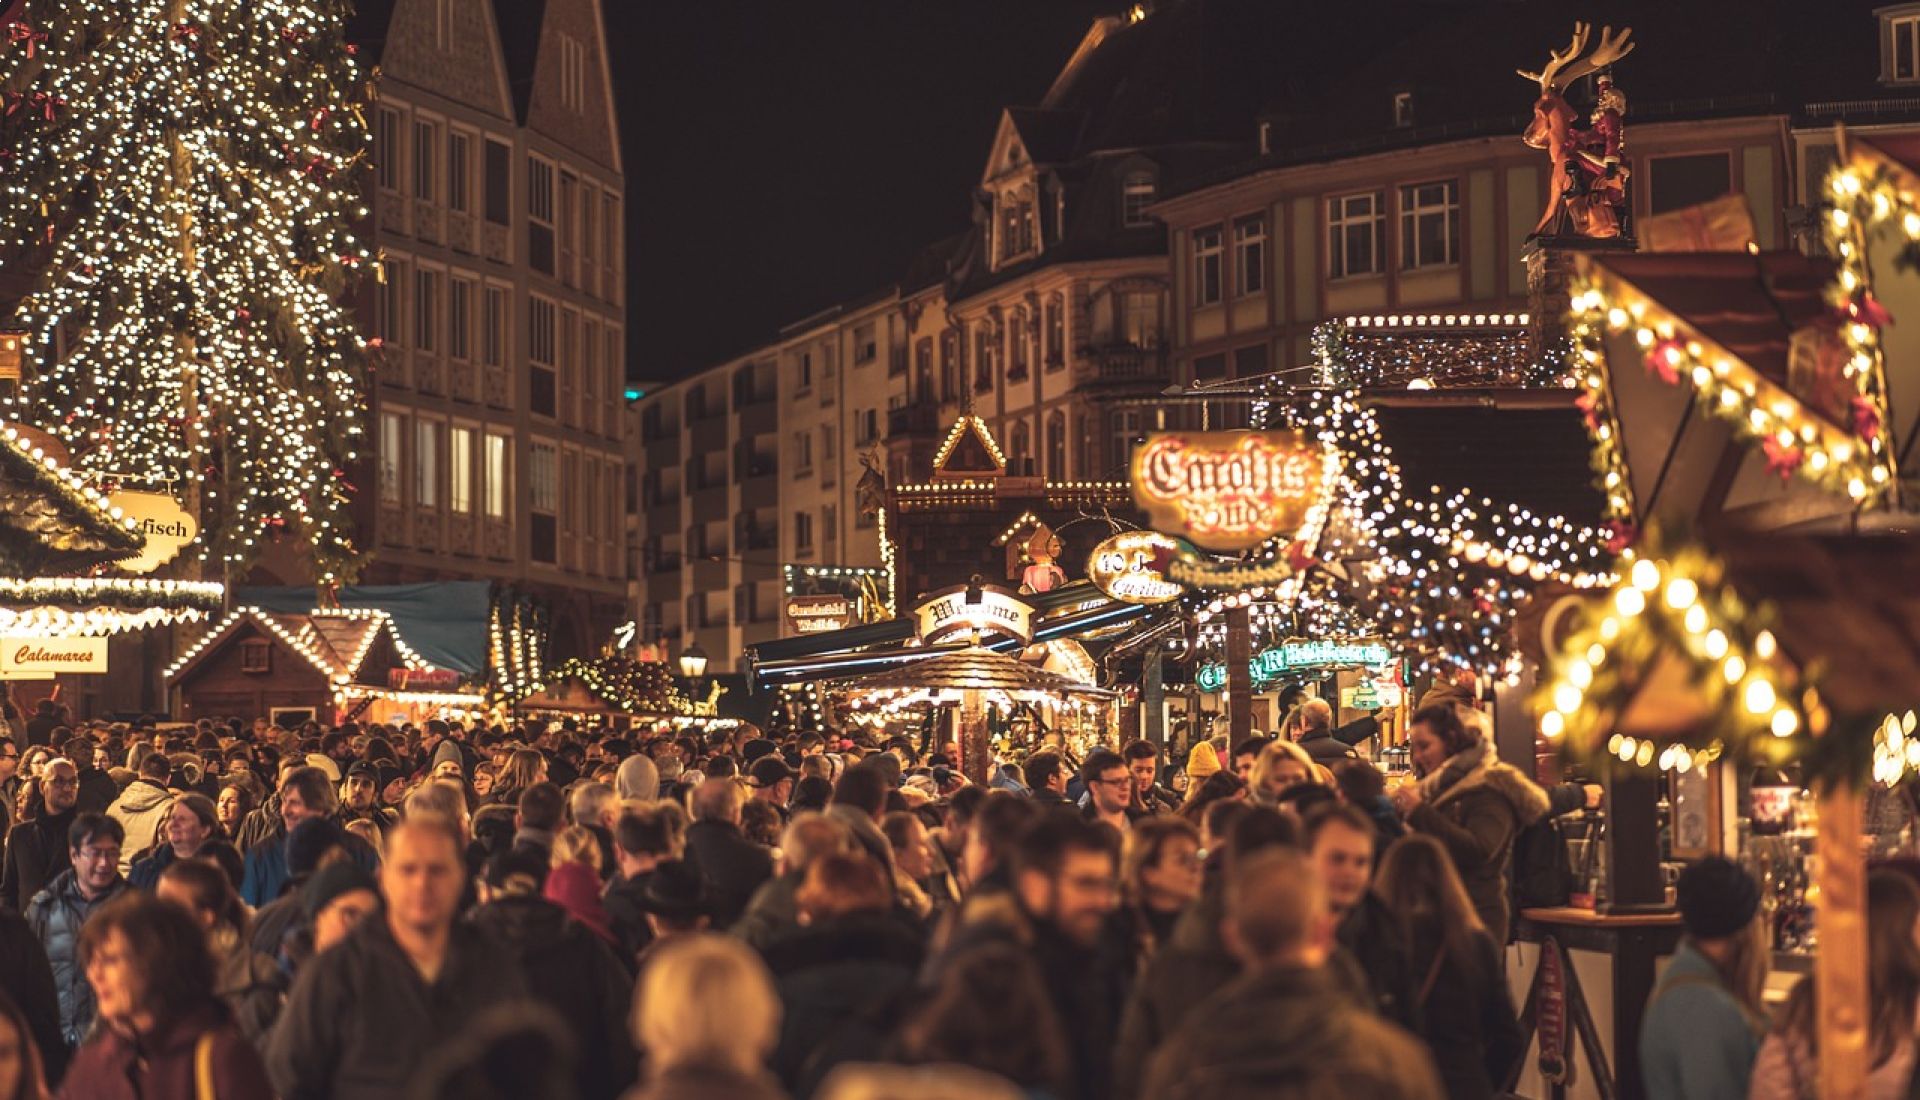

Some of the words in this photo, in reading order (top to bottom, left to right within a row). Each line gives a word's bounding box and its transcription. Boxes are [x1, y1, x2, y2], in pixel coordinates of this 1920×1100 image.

[136, 517, 187, 537] fisch
[1102, 552, 1125, 572] 10
[14, 645, 93, 665] Calamares
